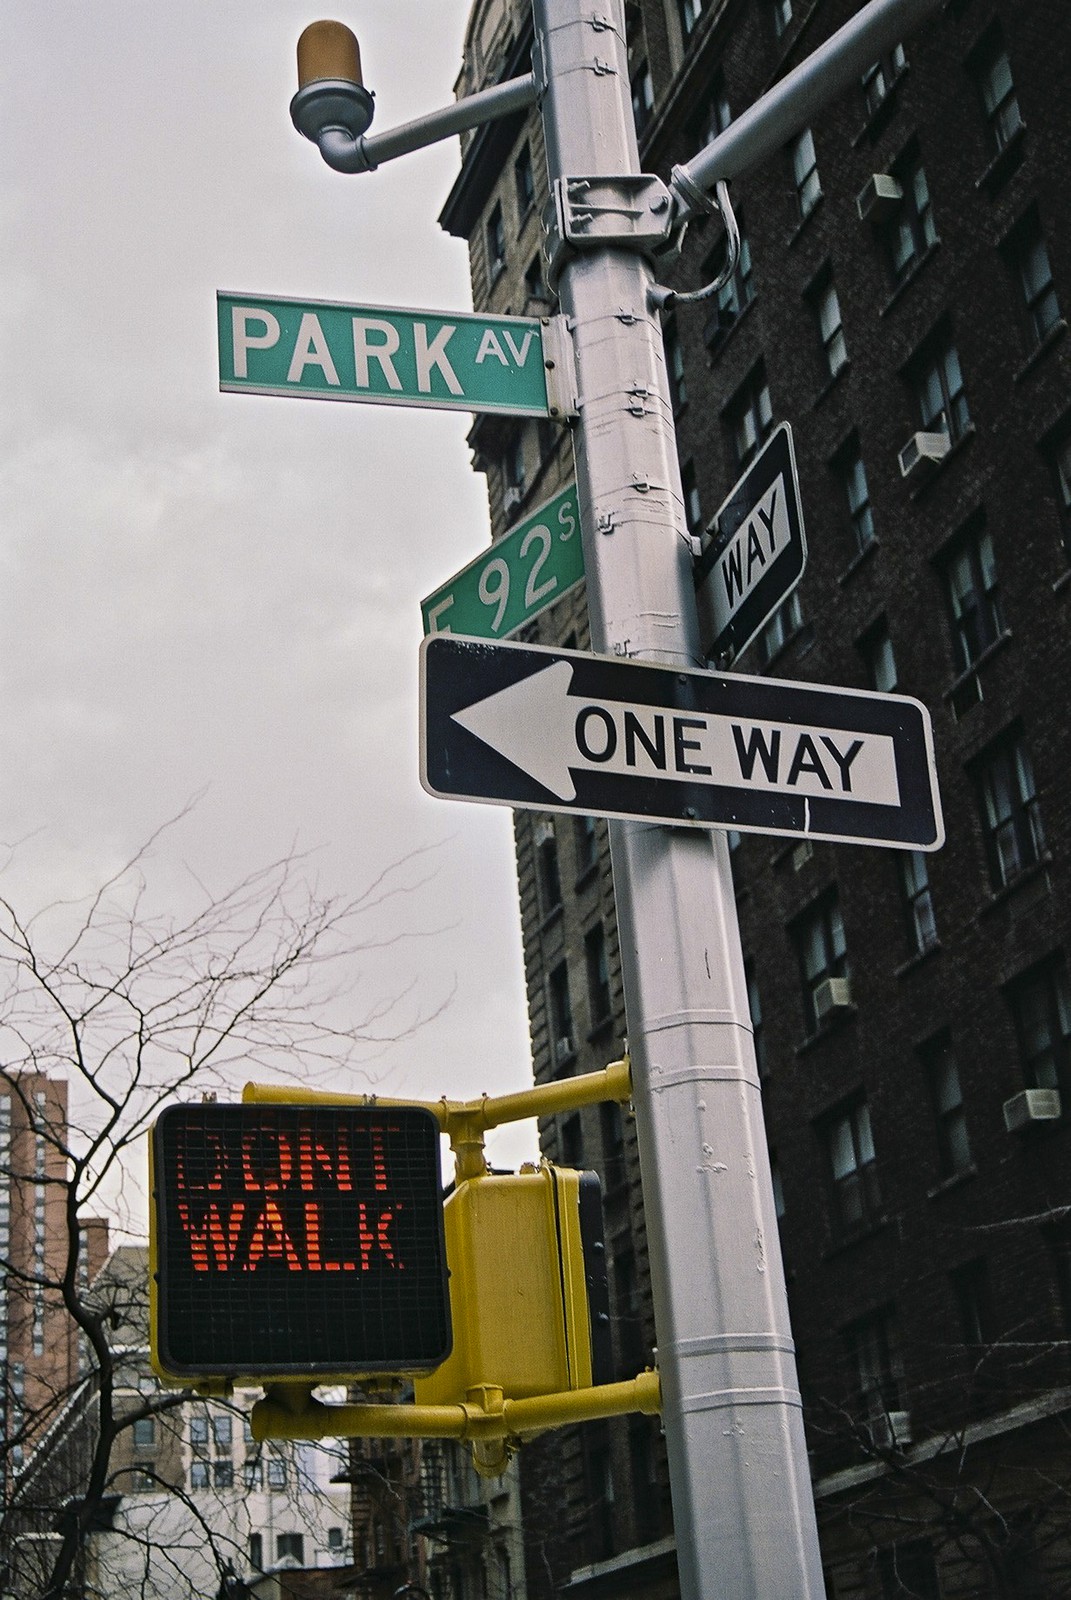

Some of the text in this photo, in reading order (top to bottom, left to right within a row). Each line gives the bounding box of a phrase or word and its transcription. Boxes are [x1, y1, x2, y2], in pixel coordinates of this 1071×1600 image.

[231, 306, 533, 396] PARK AV
[478, 500, 577, 633] 92 S
[721, 488, 778, 610] WAY
[574, 705, 865, 793] ONE WAY
[177, 1203, 404, 1271] WALK
